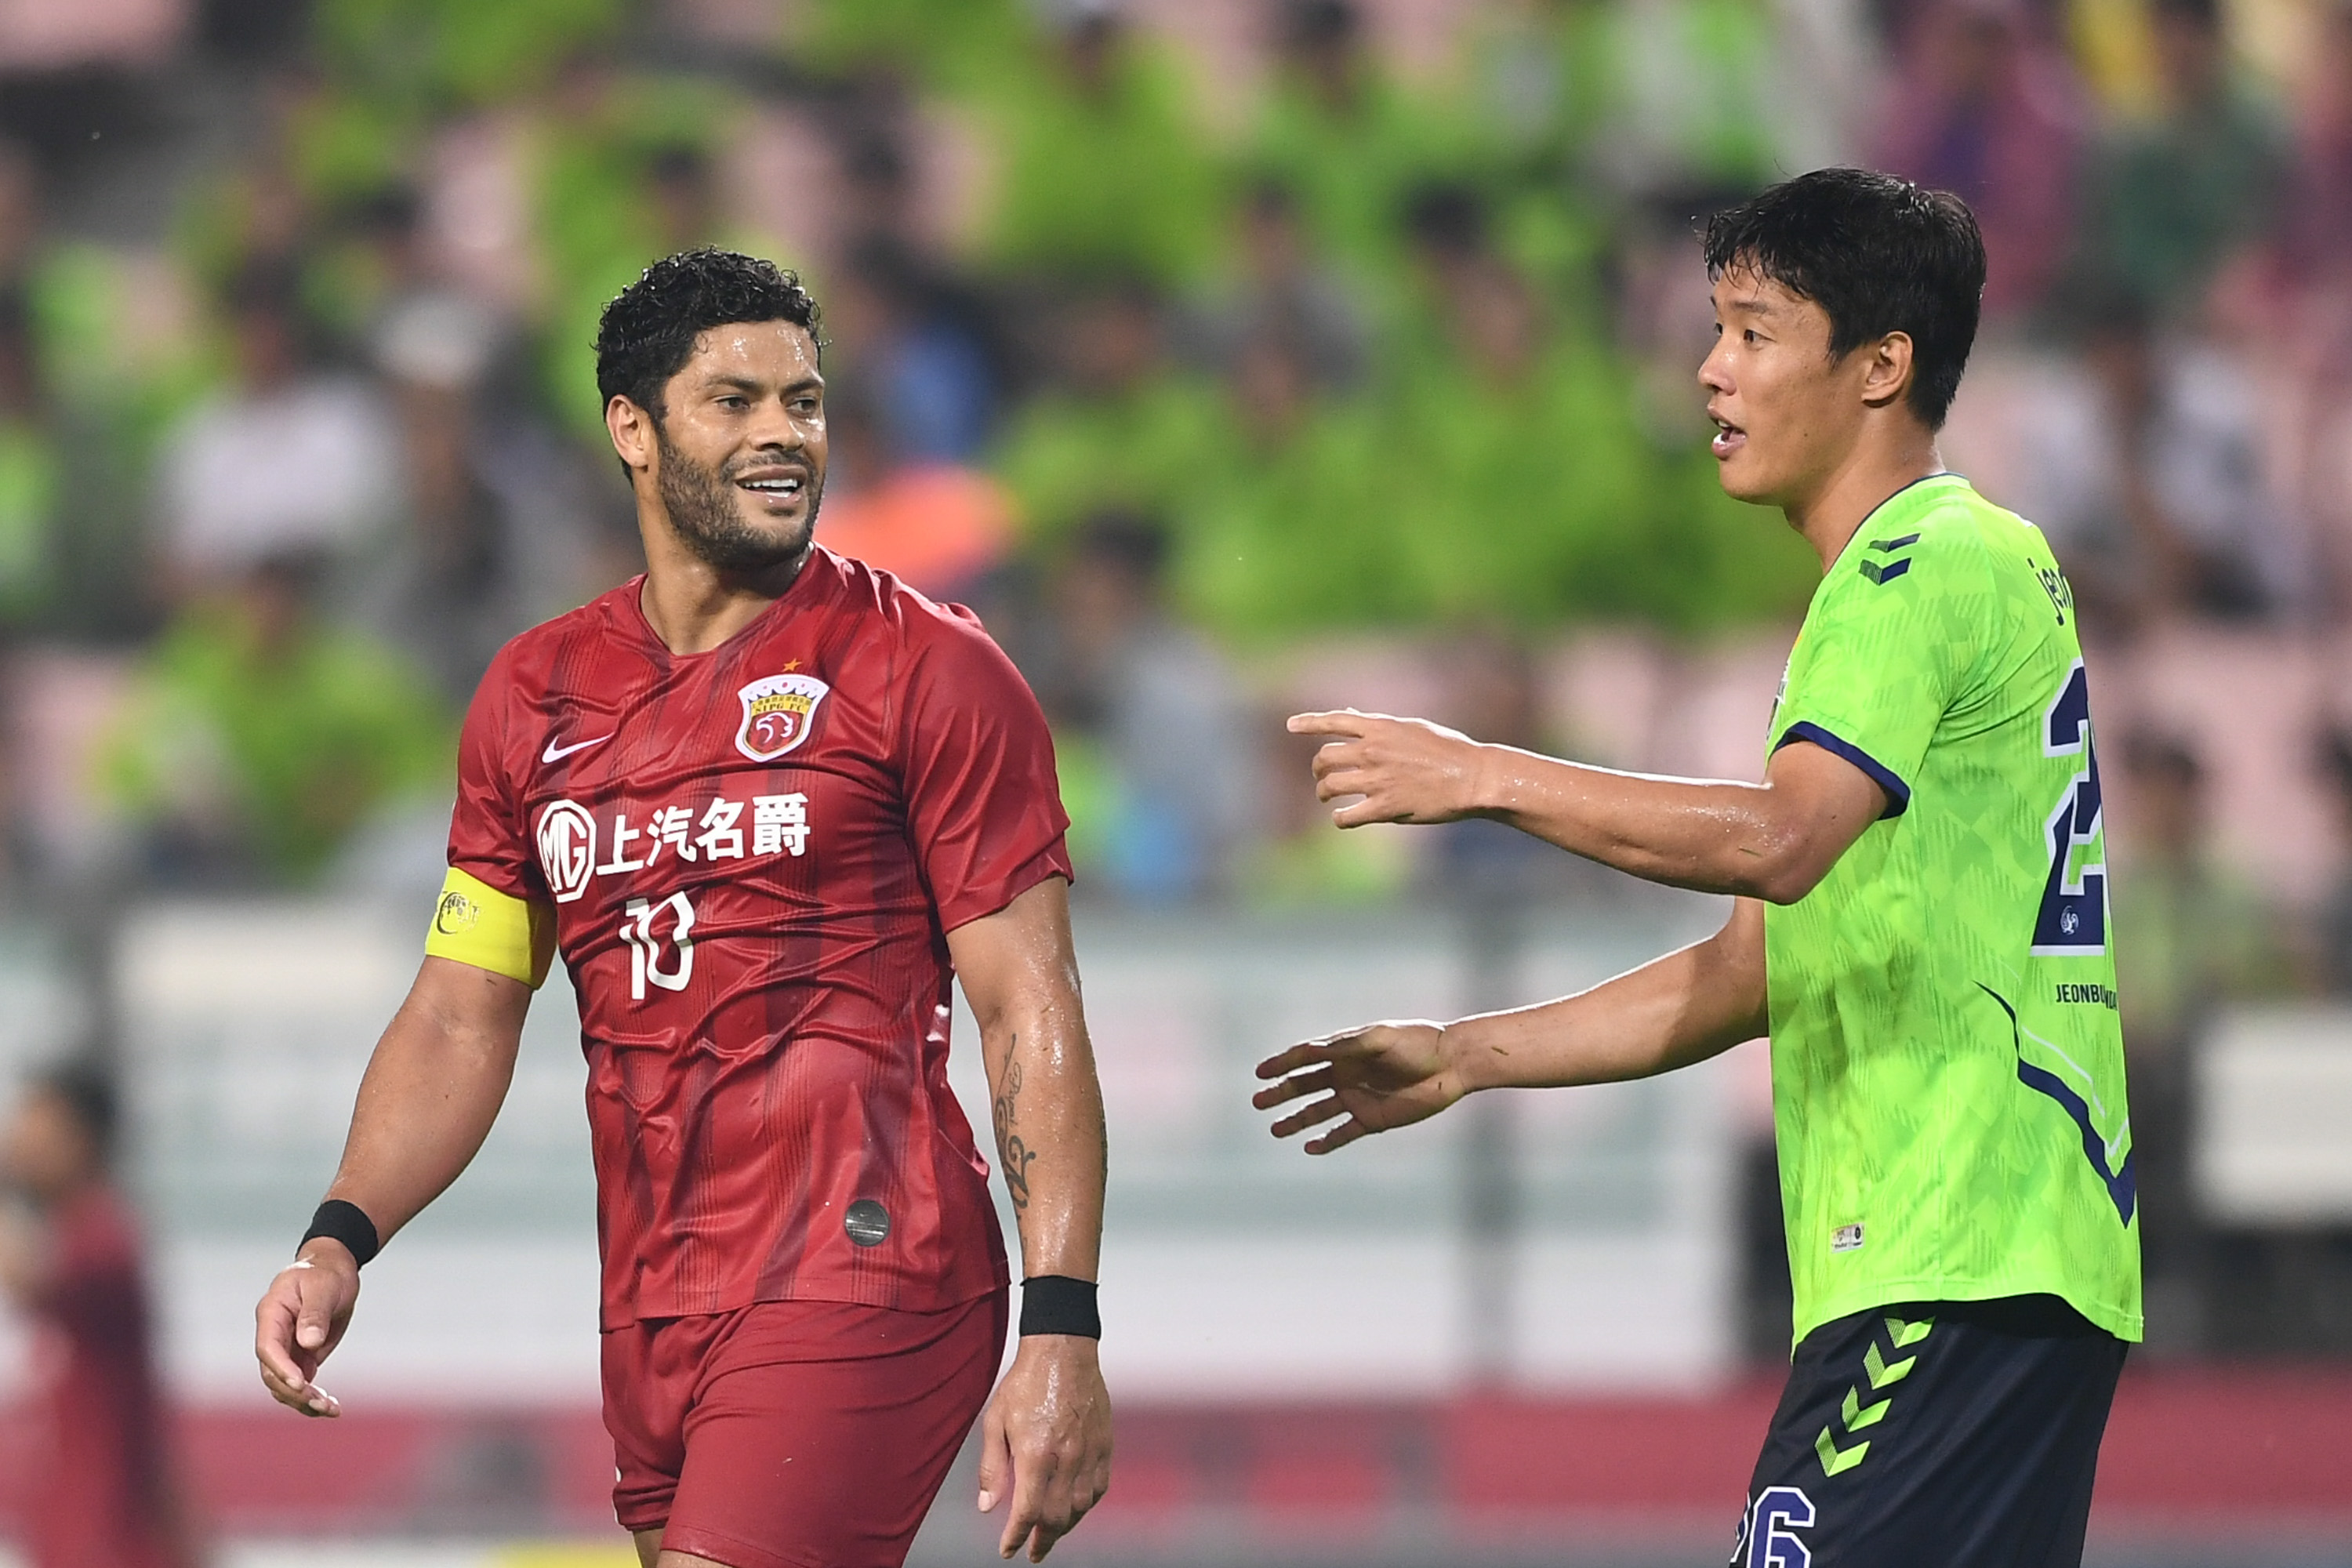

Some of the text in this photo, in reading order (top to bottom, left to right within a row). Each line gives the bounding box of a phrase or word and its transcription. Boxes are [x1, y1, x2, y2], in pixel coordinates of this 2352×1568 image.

[755, 703, 784, 713] SIPG
[540, 808, 590, 895] MG
[596, 793, 811, 876] 上汽名爵
[619, 891, 695, 1000] 10
